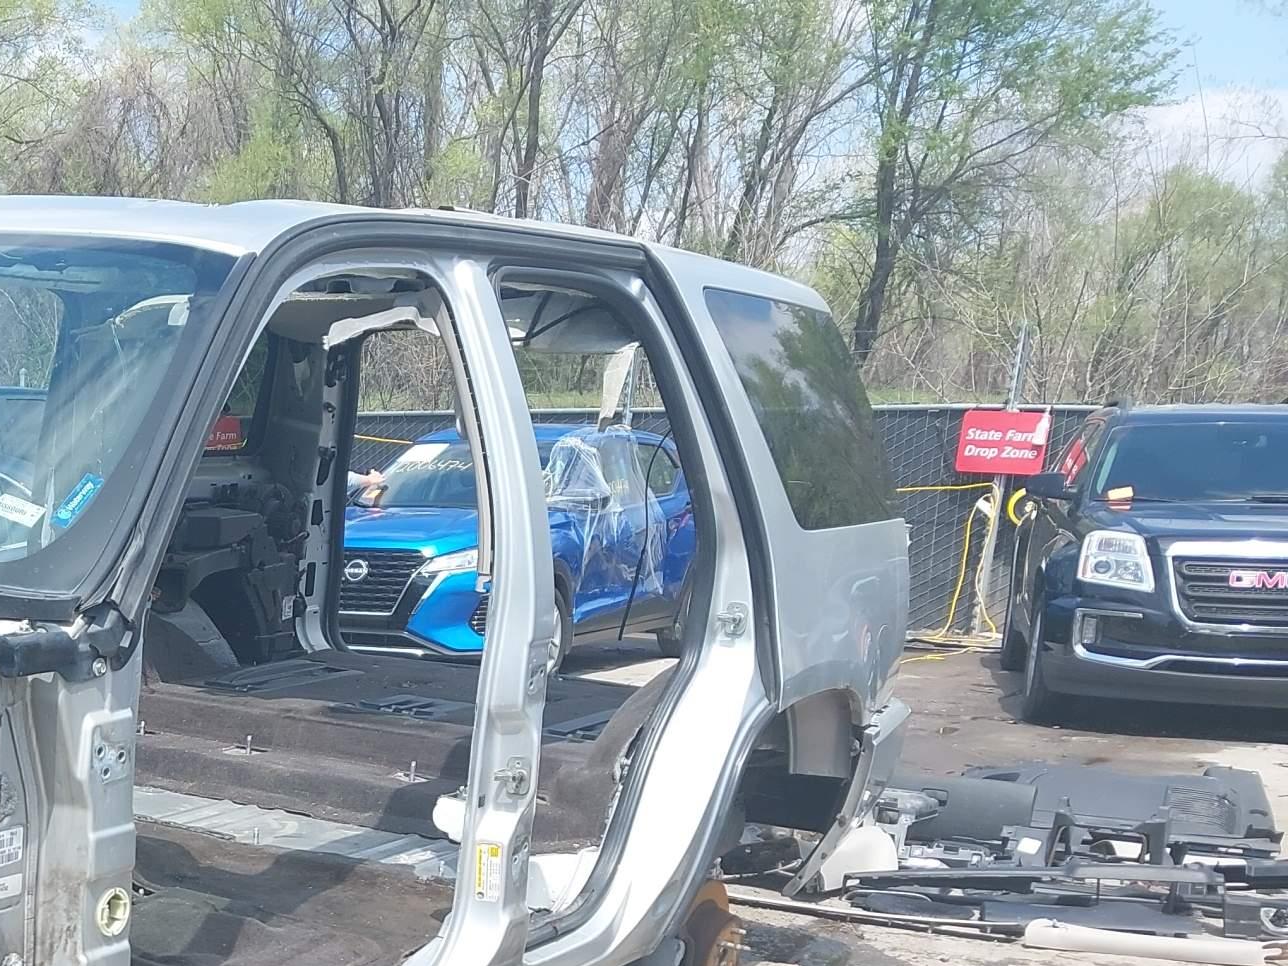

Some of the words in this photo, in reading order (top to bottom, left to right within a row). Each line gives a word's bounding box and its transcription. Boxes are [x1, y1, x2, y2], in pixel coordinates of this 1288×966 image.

[216, 431, 237, 441] Farm
[965, 428, 1003, 441] State
[964, 445, 998, 459] Drop
[1000, 445, 1038, 459] Zone
[1228, 570, 1288, 589] GM
